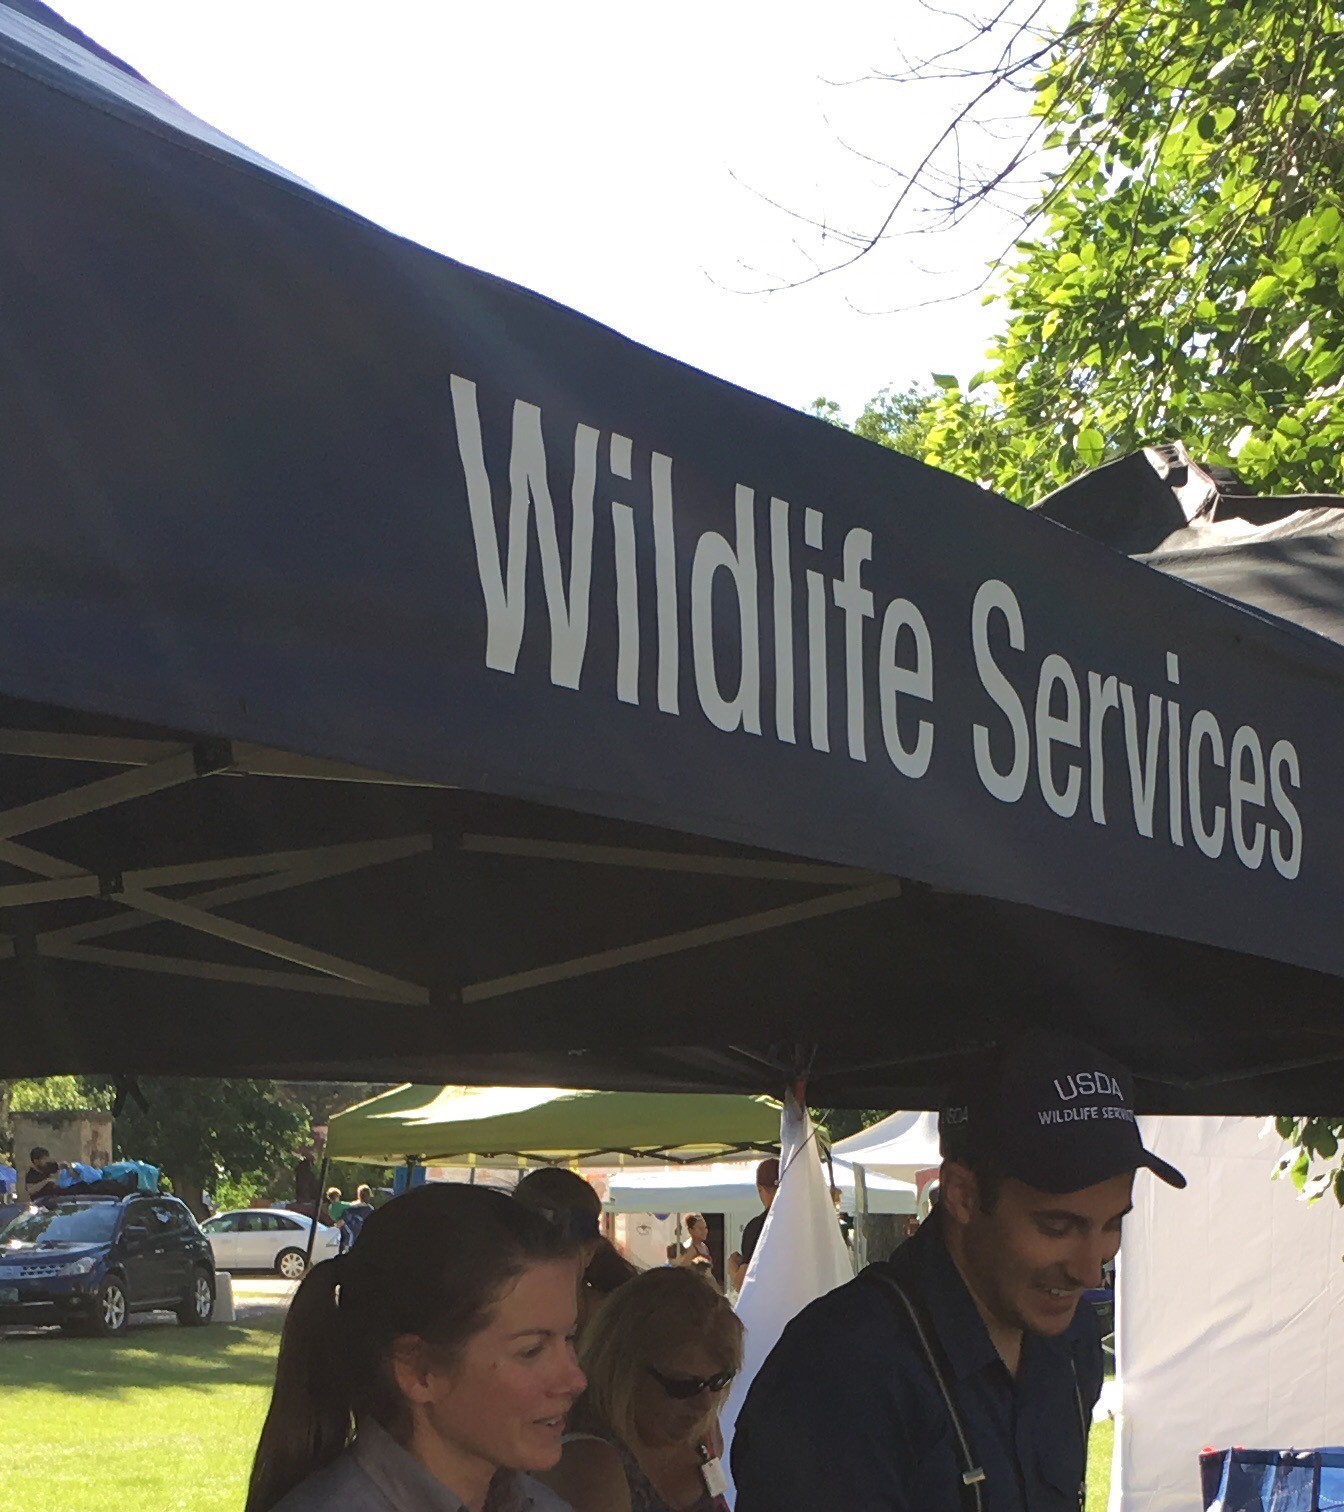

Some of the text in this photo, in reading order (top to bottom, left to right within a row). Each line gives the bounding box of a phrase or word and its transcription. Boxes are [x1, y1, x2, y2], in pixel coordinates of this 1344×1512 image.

[448, 373, 1303, 881] Wildlife Services
[1053, 1071, 1124, 1101] USDA
[1037, 1107, 1099, 1125] WILDLIFE
